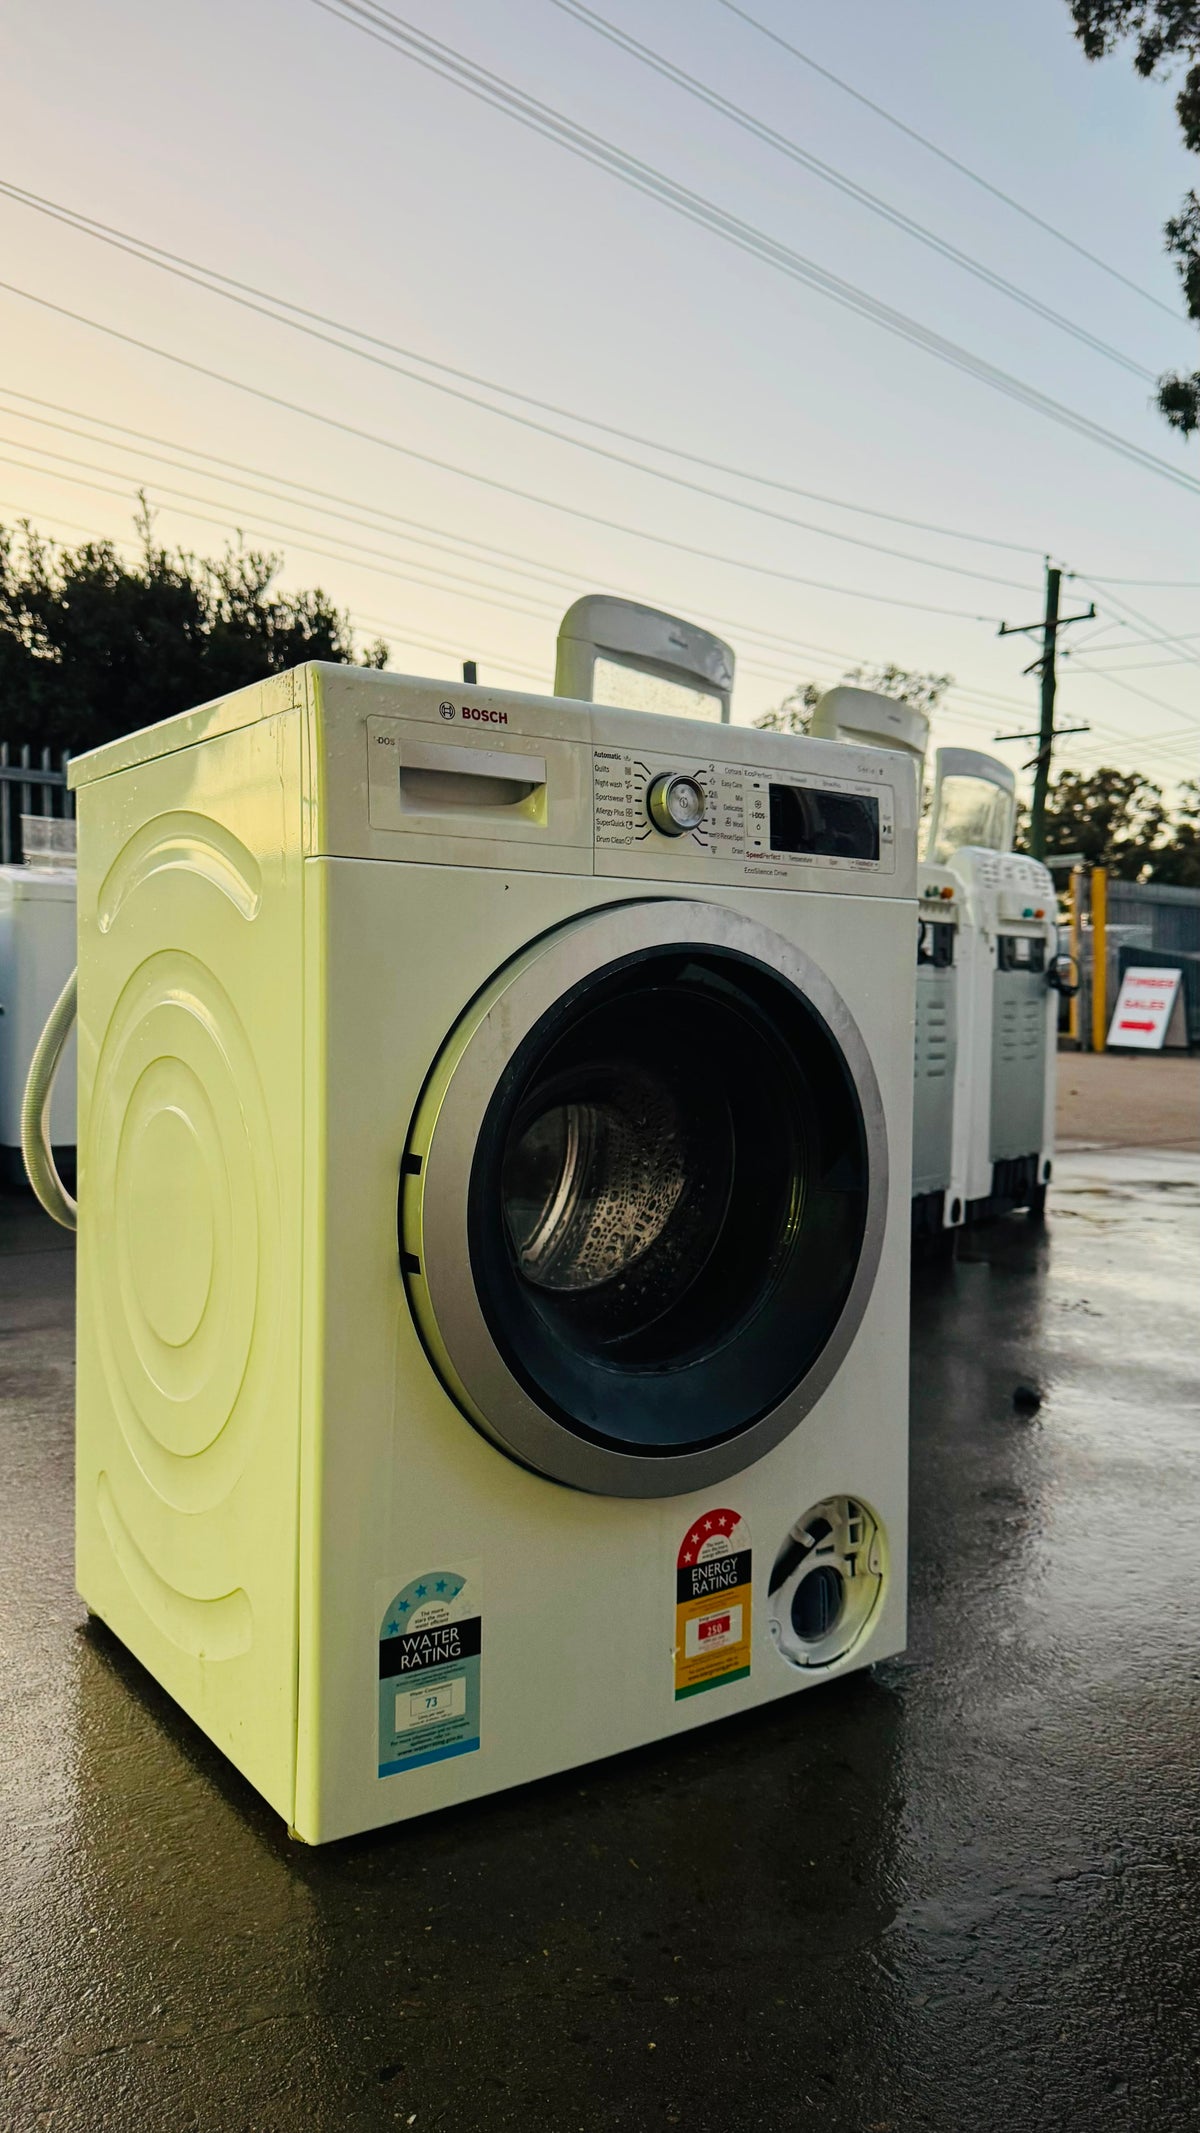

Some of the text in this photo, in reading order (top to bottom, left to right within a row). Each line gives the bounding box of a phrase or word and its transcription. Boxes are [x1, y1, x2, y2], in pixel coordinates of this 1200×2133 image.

[462, 707, 508, 724] BOSCH
[594, 751, 621, 760] Automatic
[594, 764, 610, 773] Quilts
[595, 779, 609, 788] Night
[595, 792, 624, 802] Sportswear
[596, 808, 625, 817] Allergy Plus
[596, 818, 625, 828] SuperQuick
[611, 836, 625, 844] Clean
[745, 851, 781, 861] SpeedPerfect
[744, 866, 773, 875] EcoSilence
[1125, 975, 1175, 989] TIMBER
[1124, 1000, 1165, 1011] SALES
[691, 1557, 738, 1582] ENERGY
[692, 1571, 738, 1596] RATING
[402, 1627, 459, 1653] WATER
[401, 1642, 461, 1670] RATING
[425, 1696, 438, 1708] 73
